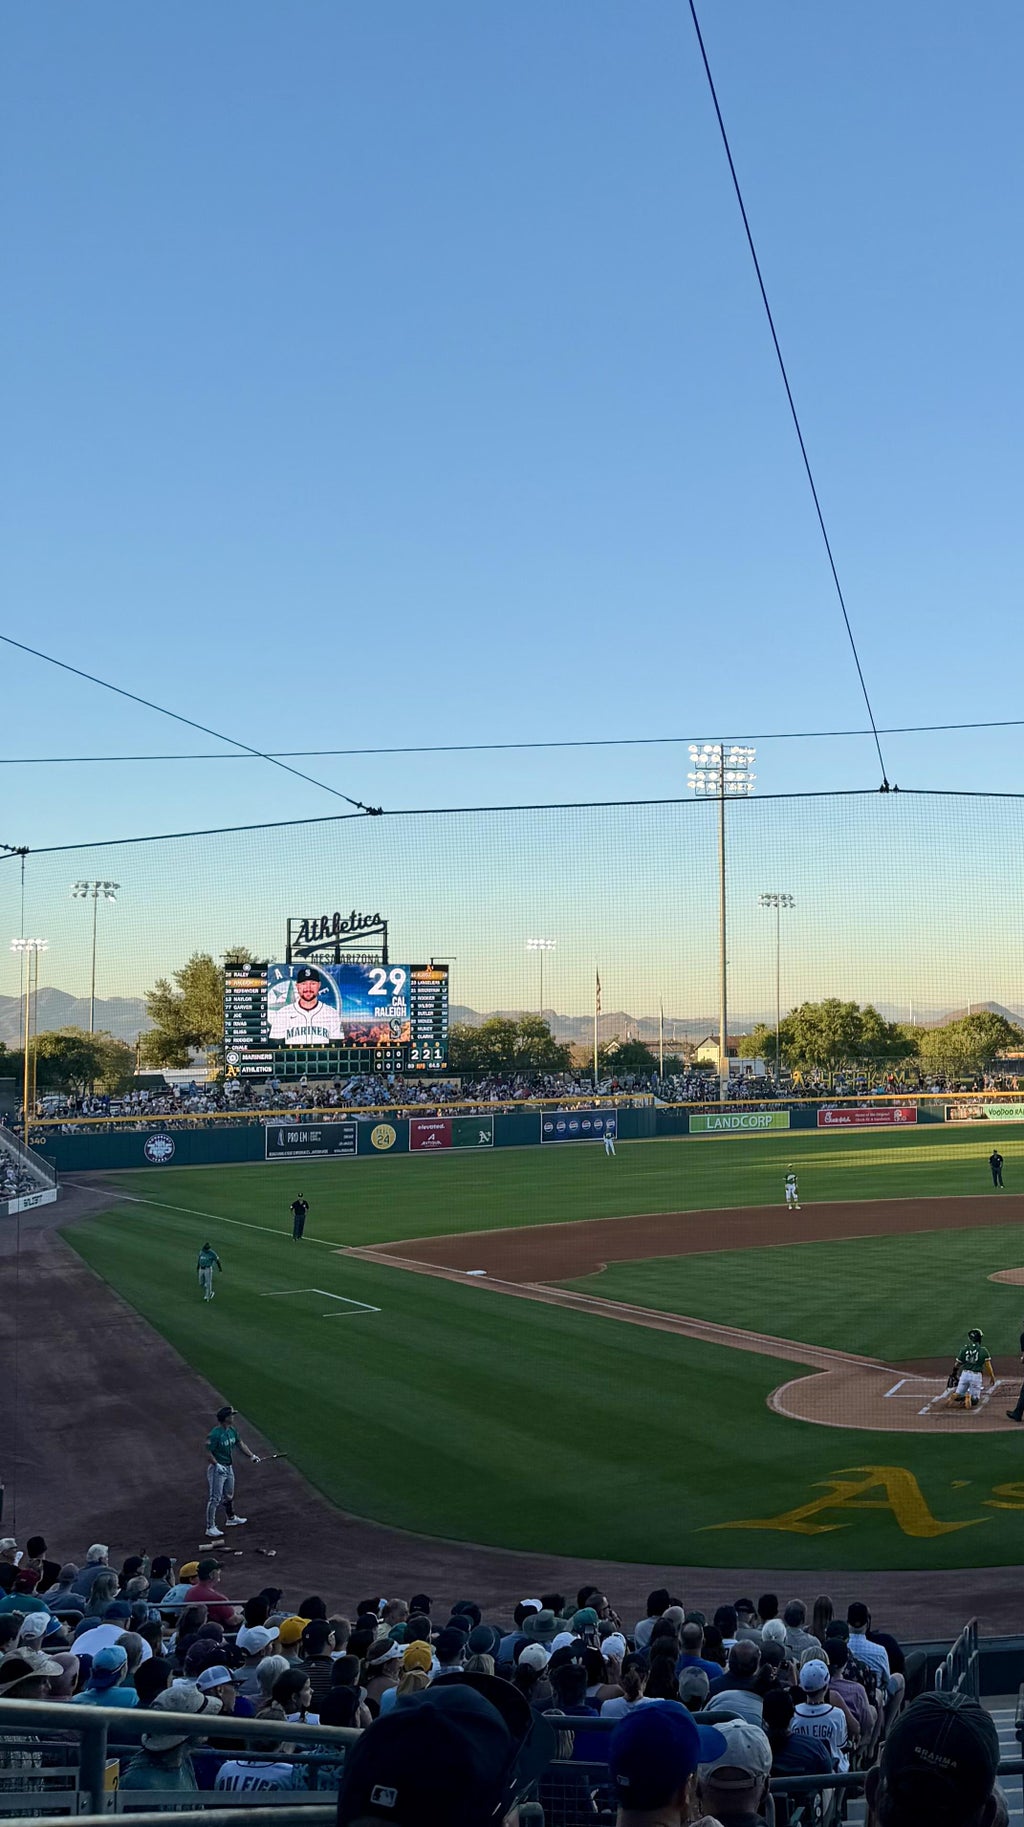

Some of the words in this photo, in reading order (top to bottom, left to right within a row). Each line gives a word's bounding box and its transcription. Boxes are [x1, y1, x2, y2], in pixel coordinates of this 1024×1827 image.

[292, 910, 385, 948] Athletics
[311, 953, 336, 964] MESA
[340, 953, 380, 964] ARIZONA
[368, 968, 406, 995] 29
[392, 997, 406, 1006] CAL
[374, 1007, 407, 1017] RALEIGH
[411, 1050, 419, 1060] 2
[422, 1049, 430, 1059] 2
[434, 1049, 442, 1059] 1
[988, 1108, 1014, 1116] VOODOO
[706, 1115, 772, 1129] LANDCORP
[29, 1137, 46, 1145] 340
[287, 1132, 299, 1143] PRO
[300, 1131, 308, 1142] EM
[377, 1135, 390, 1145] 24
